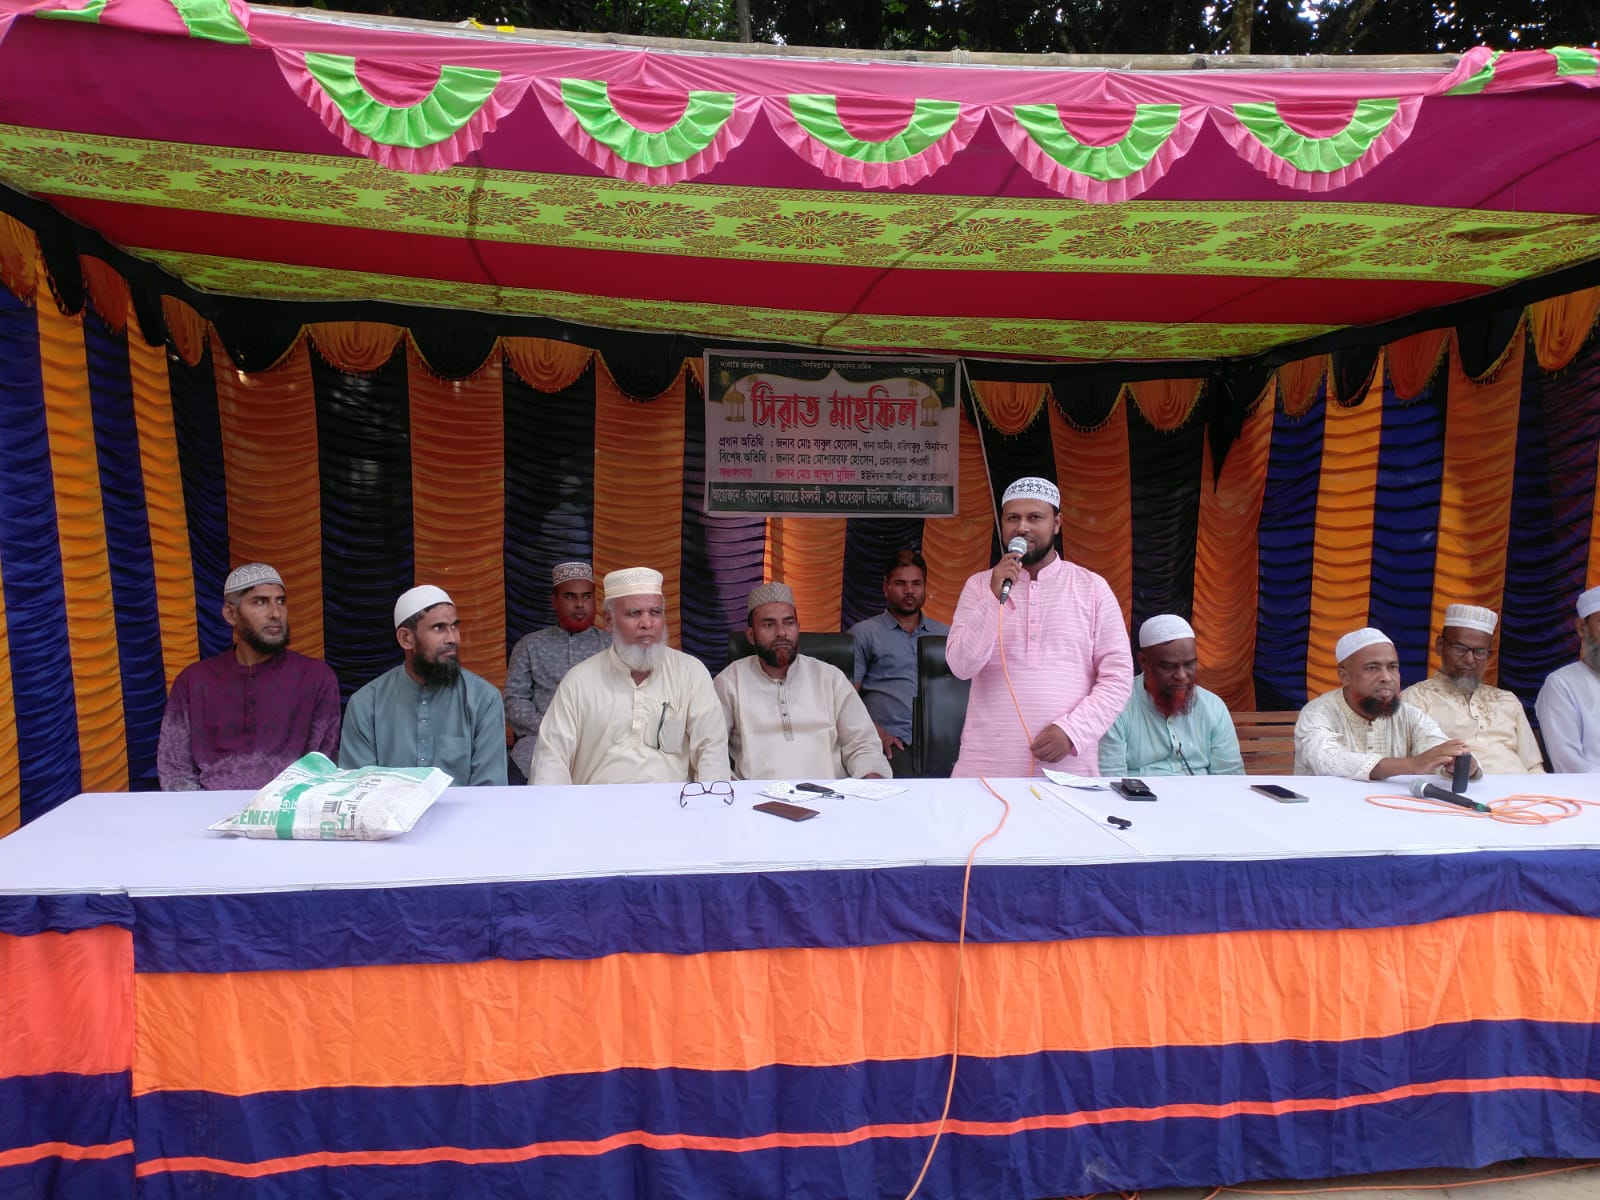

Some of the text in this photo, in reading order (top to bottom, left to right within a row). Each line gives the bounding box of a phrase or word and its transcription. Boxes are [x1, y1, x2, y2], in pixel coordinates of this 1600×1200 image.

[750, 381, 919, 433] সিরাত মাহফিল
[719, 436, 738, 449] প্রধান
[740, 434, 764, 449] অতিথি
[776, 438, 795, 449] জনাব
[813, 439, 832, 451] বাবুল
[719, 449, 741, 463] বিশেষ
[743, 449, 767, 463] অতিথি
[776, 453, 795, 464] জনাব
[776, 468, 795, 480] জনাব
[745, 489, 771, 504] বাংলাদেশ
